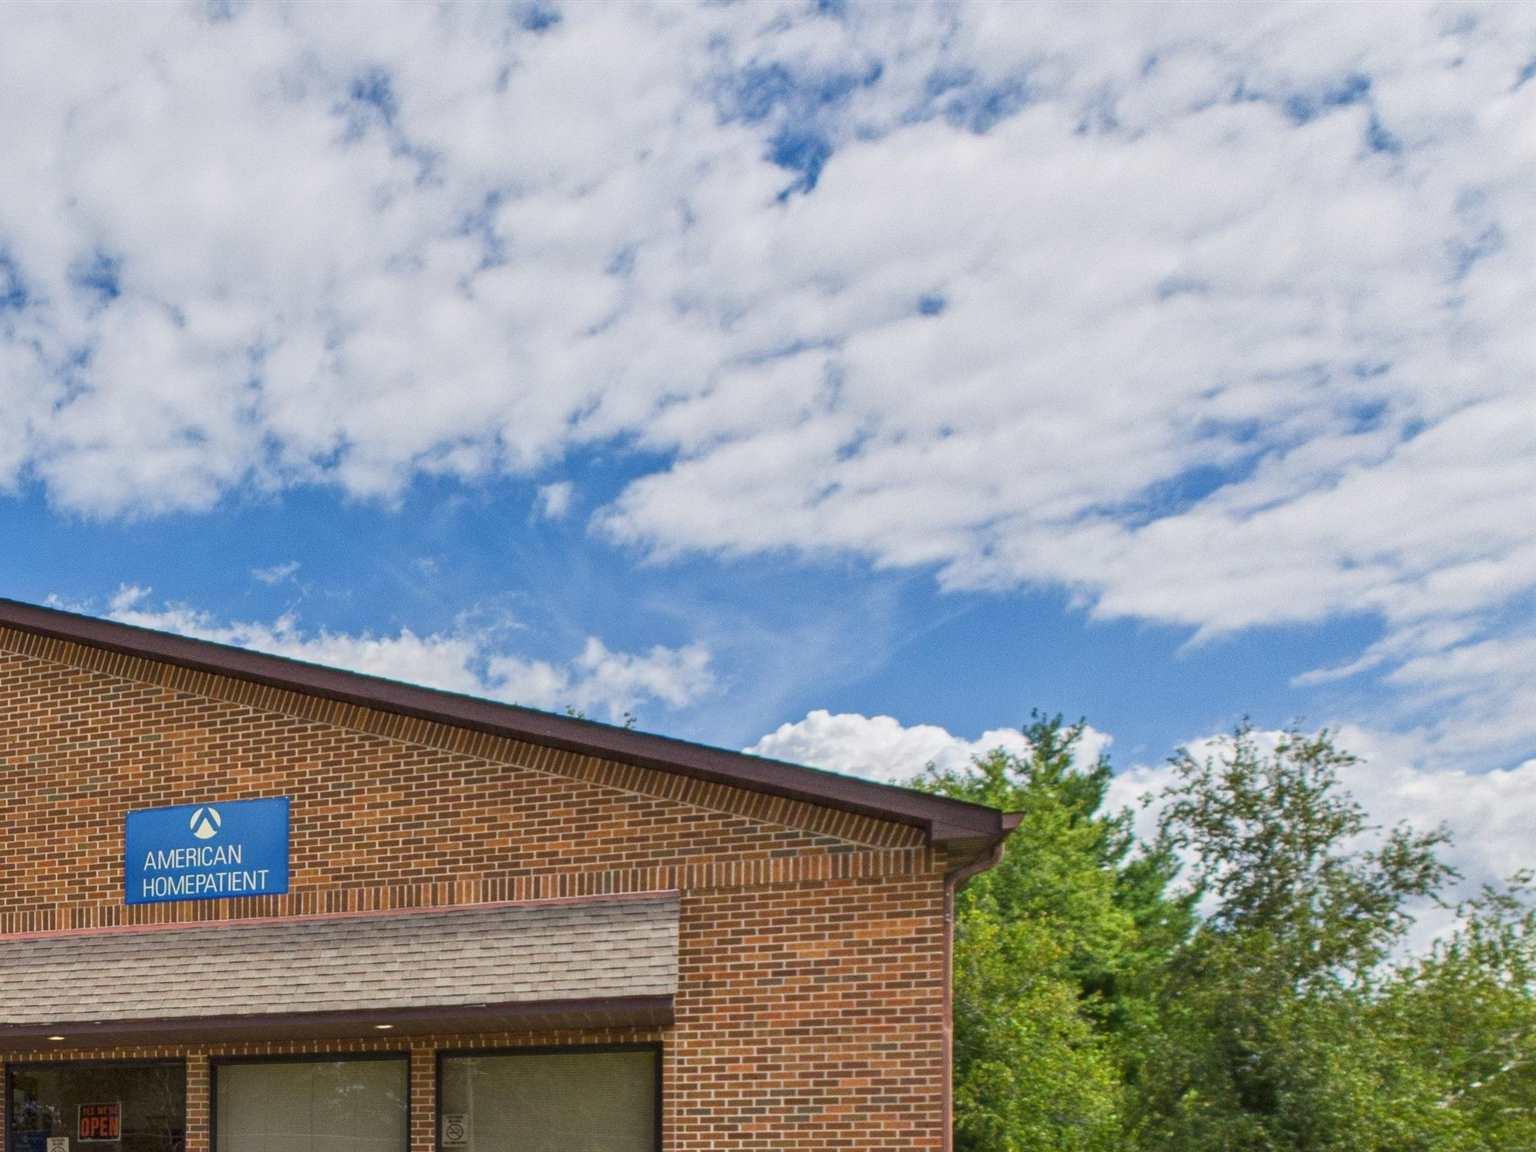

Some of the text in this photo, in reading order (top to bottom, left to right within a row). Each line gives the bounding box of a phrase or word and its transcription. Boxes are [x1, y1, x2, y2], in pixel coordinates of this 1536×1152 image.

[143, 844, 242, 871] AMERICAN
[142, 870, 269, 898] HOMEPATIENT
[81, 1117, 119, 1137] OPEN
